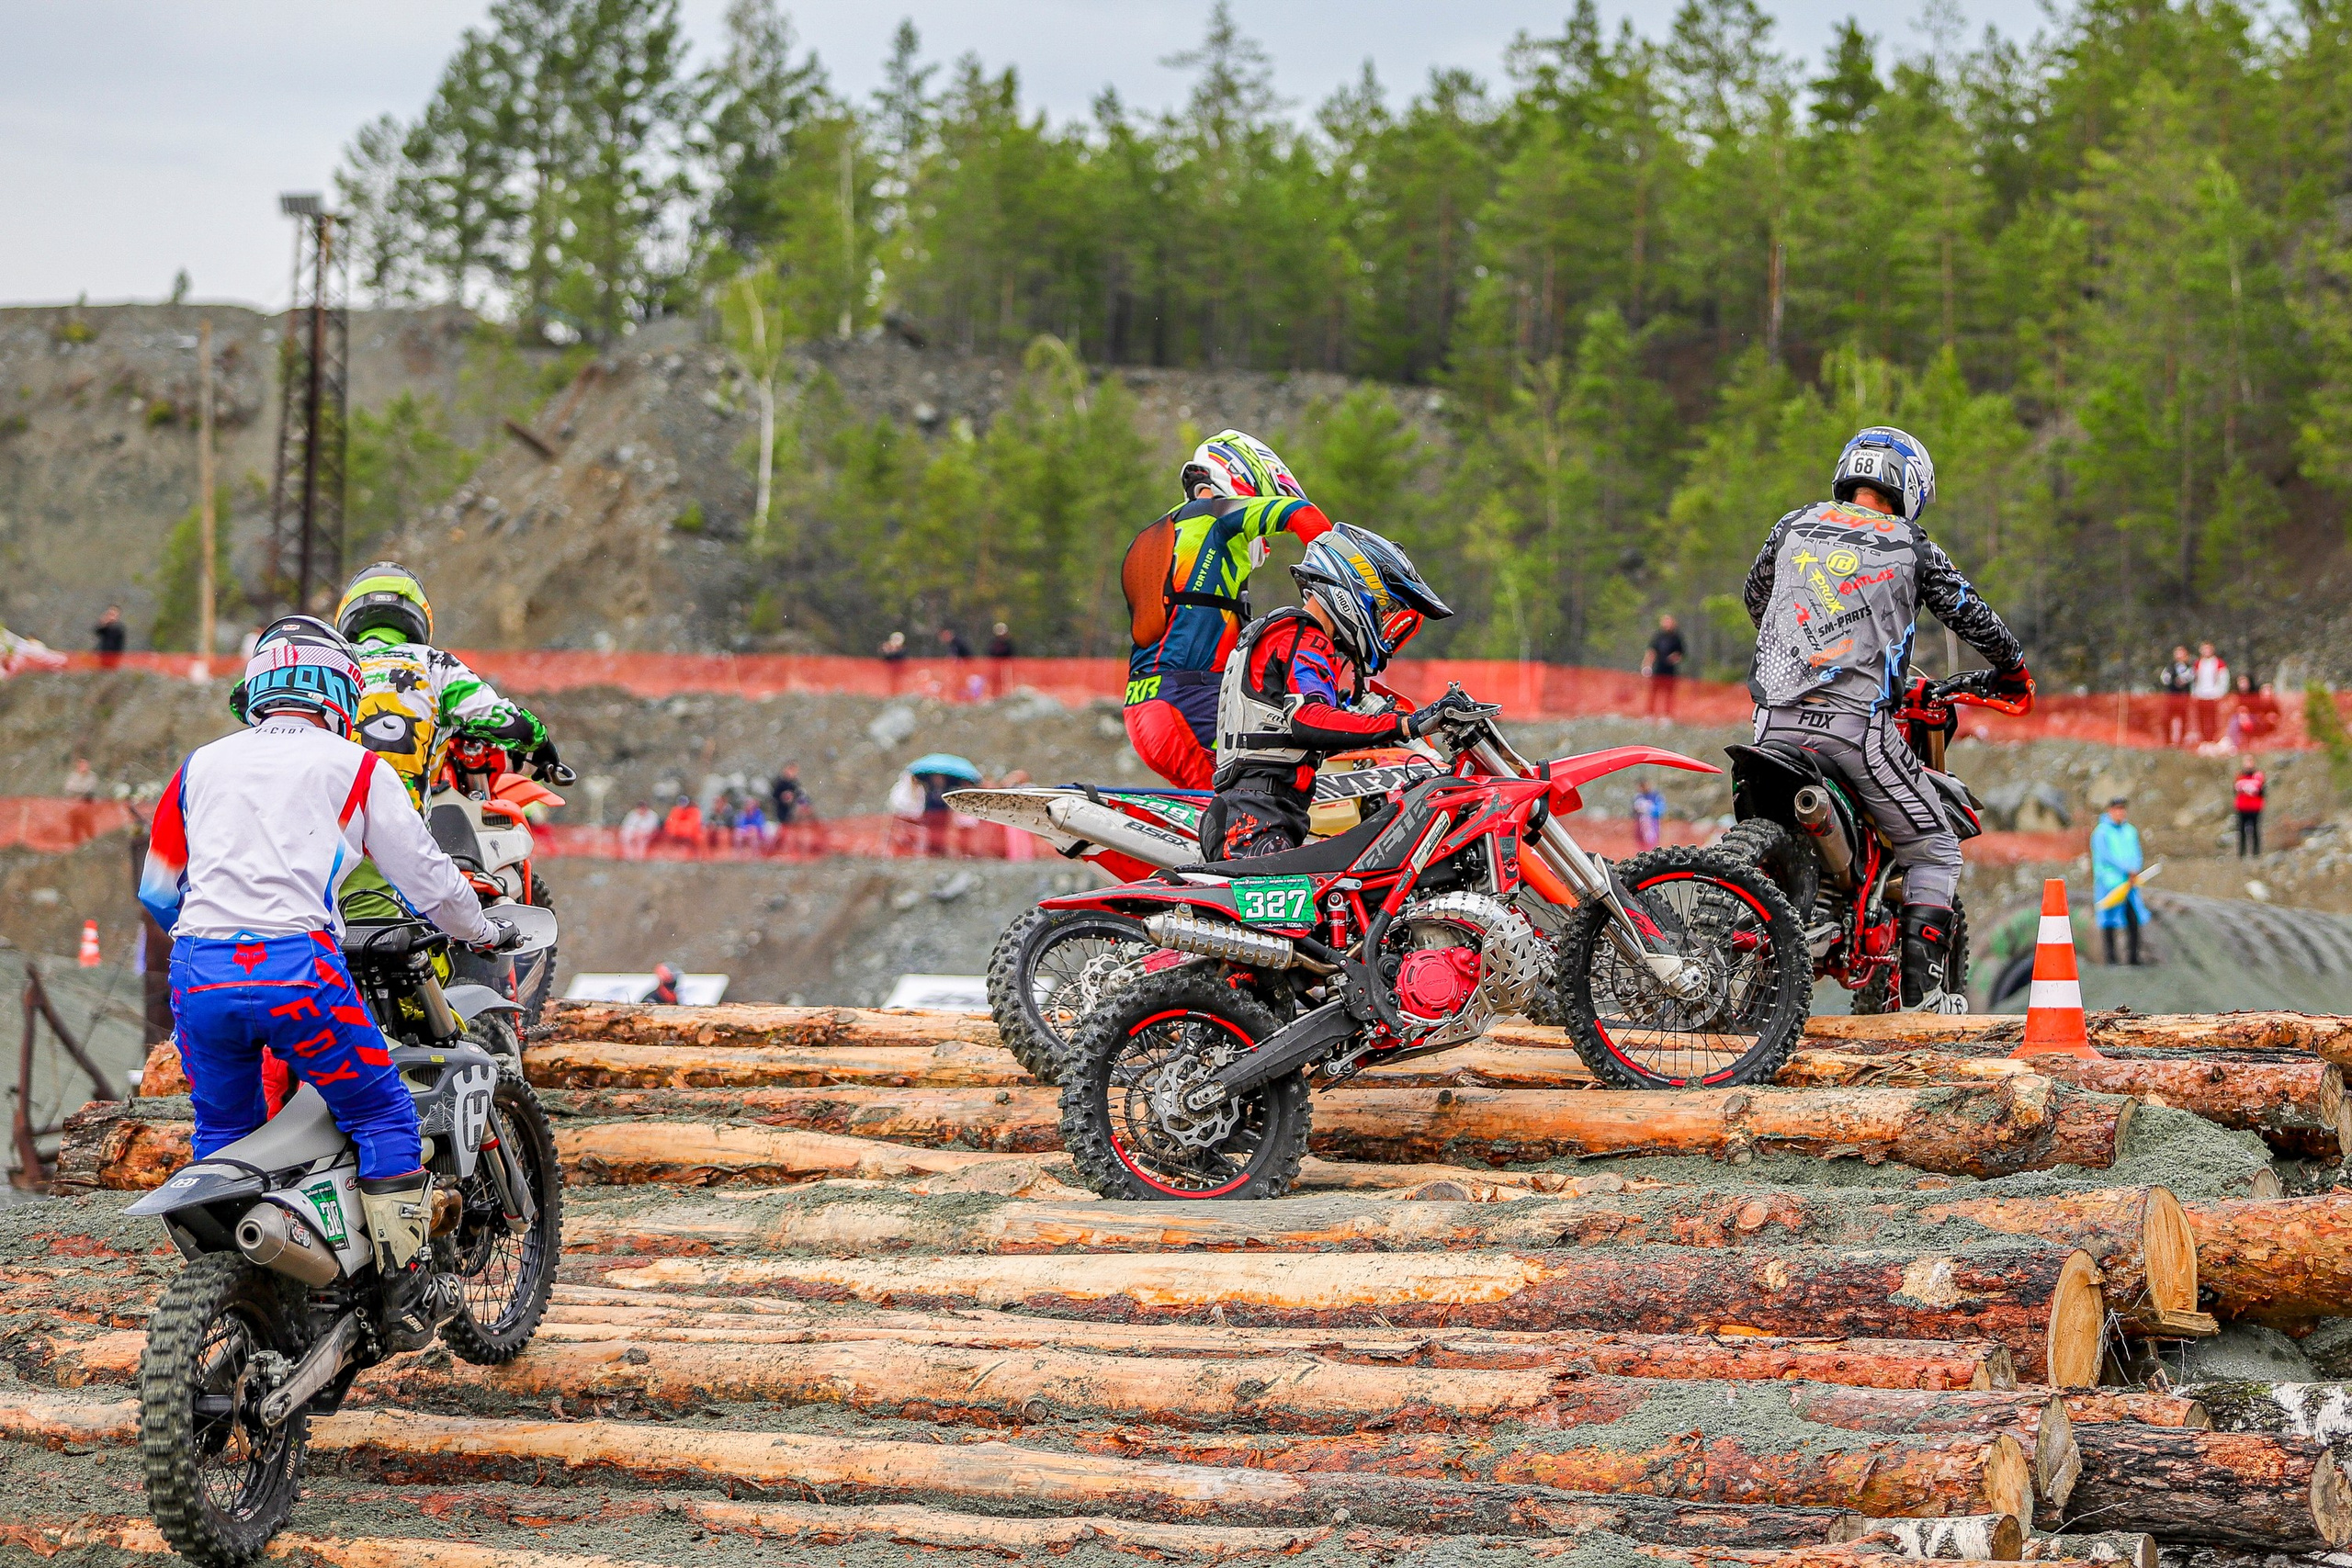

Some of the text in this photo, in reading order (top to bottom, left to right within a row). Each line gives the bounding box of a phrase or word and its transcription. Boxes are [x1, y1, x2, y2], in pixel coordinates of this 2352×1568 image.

[1854, 457, 1874, 474] 68
[1202, 548, 1216, 570] RIDE
[1804, 538, 1881, 557] RACING
[1348, 553, 1390, 606] 100%
[1335, 591, 1351, 613] SHOEI
[1818, 605, 1872, 637] SM-PARTS
[1124, 675, 1162, 705] FXR
[1266, 713, 1287, 725] FOX
[1798, 712, 1836, 729] FOX
[1899, 739, 1924, 785] OX
[1245, 890, 1307, 919] 327
[269, 996, 359, 1086] FOX
[286, 1450, 297, 1480] GRIP
